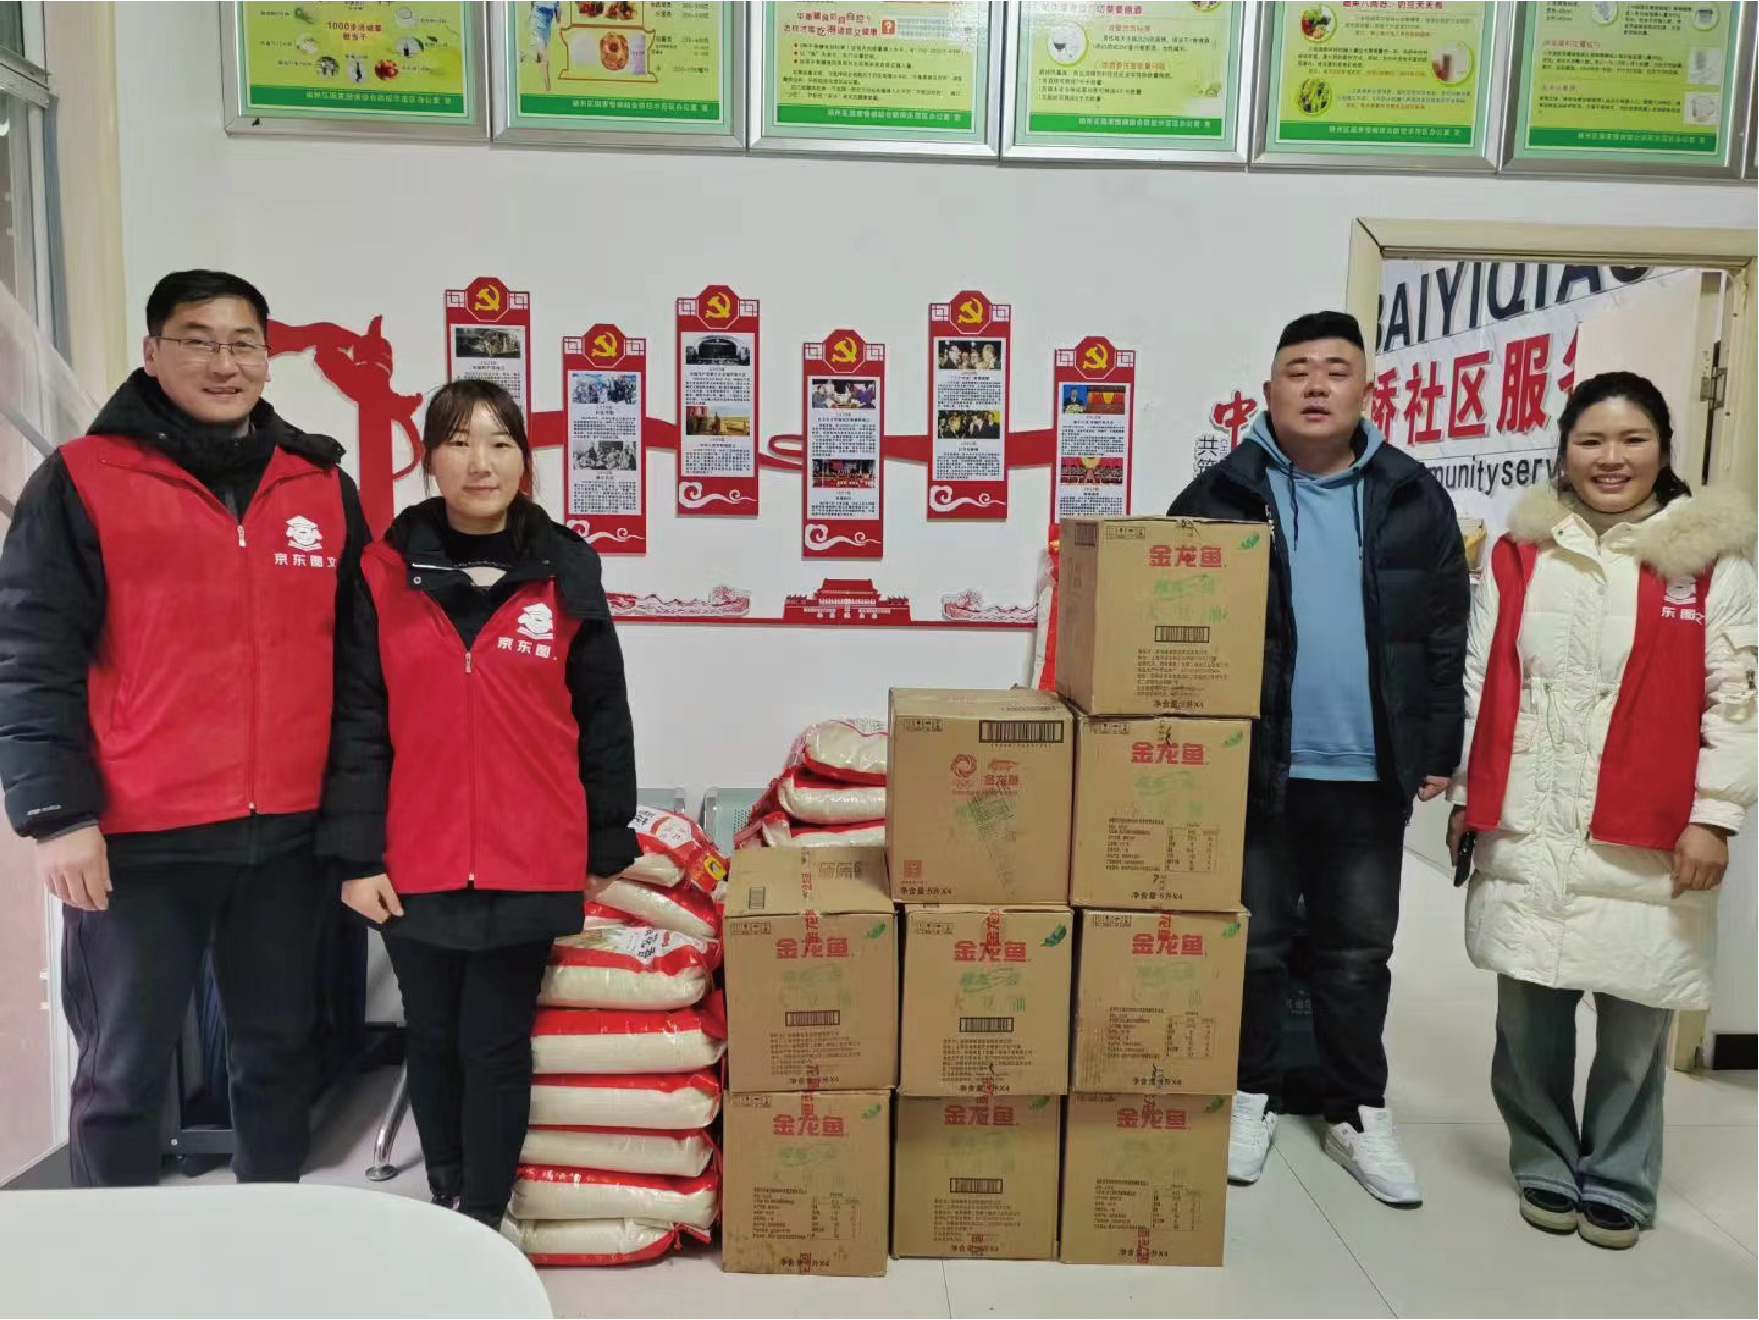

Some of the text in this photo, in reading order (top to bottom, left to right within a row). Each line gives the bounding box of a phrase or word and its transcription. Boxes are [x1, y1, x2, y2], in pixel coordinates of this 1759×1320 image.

[1149, 545, 1222, 567] 金龙鱼
[497, 636, 557, 660] 京东图
[1131, 742, 1203, 765] 金龙鱼
[776, 938, 850, 958] 金龙鱼
[954, 940, 1027, 962] 金龙鱼
[1132, 934, 1203, 955] 金龙鱼
[773, 1114, 845, 1136] 金龙鱼
[944, 1105, 1015, 1126] 金龙鱼
[1116, 1107, 1188, 1130] 金龙鱼
